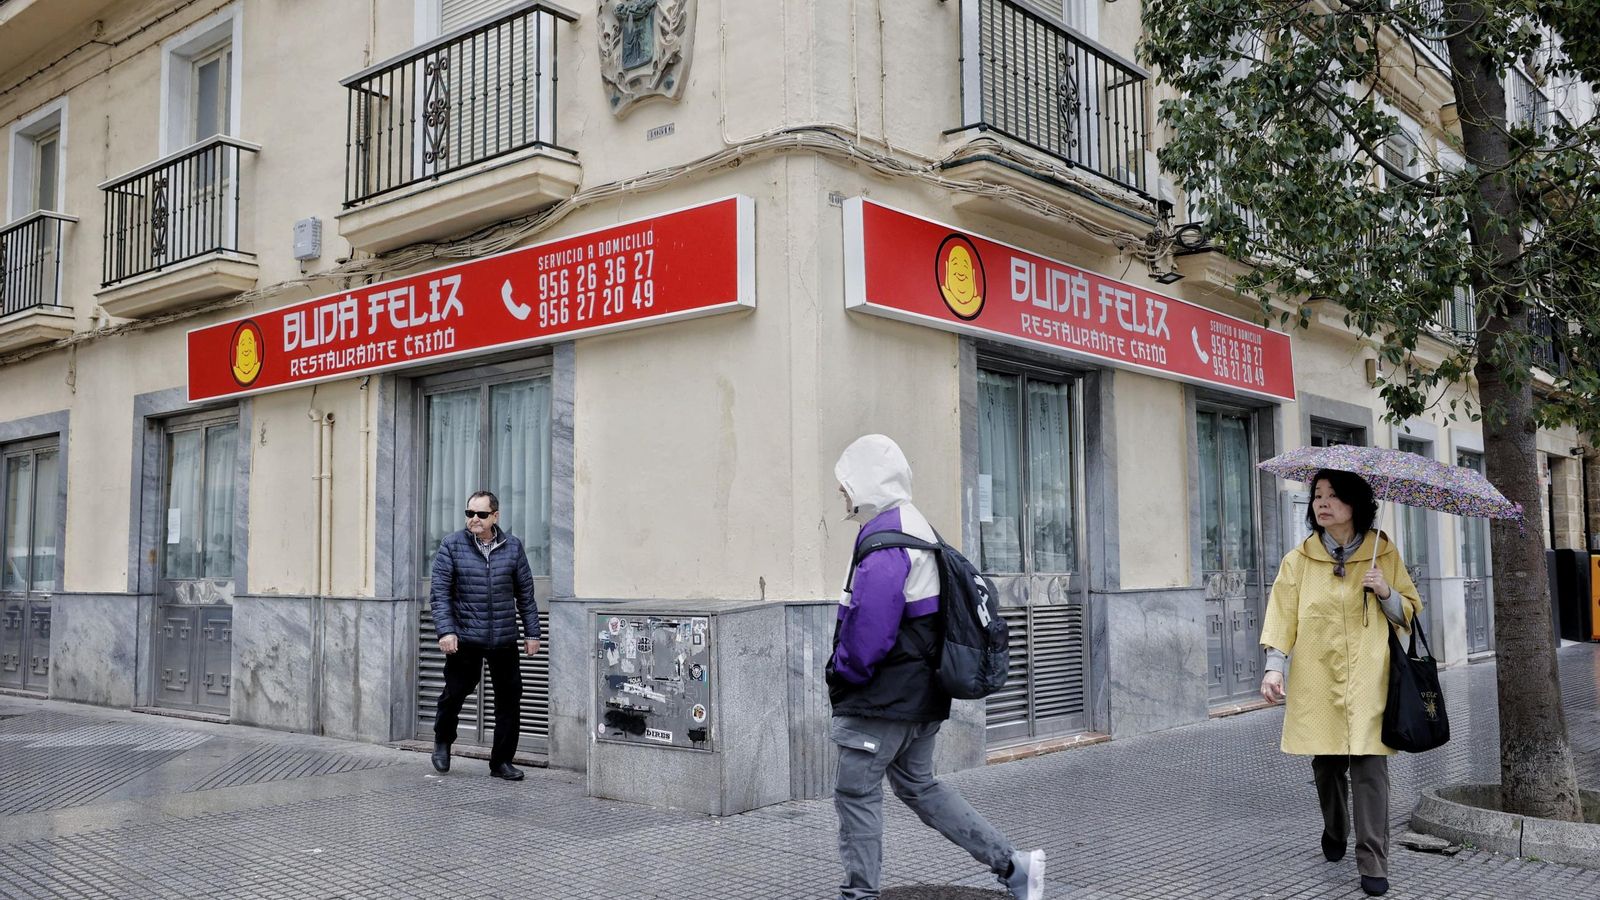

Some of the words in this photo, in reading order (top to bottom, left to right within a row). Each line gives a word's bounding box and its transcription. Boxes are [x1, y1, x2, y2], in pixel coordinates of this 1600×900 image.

[538, 246, 583, 271] SERVICIO
[587, 244, 594, 260] A
[598, 230, 653, 257] DOMICILIO
[538, 268, 569, 301] 956
[576, 262, 597, 293] 26
[604, 255, 626, 287] 36
[634, 249, 654, 281] 27
[367, 273, 464, 335] FELIZ
[538, 296, 569, 328] 956
[576, 291, 596, 321] 27
[603, 285, 624, 317] 20
[631, 279, 654, 310] 49
[1097, 283, 1171, 341] FELIZ
[290, 339, 397, 377] RESTAURANTE
[403, 326, 455, 356] CHINO
[1020, 312, 1126, 356] RESTAURANTE
[1130, 338, 1167, 365] CHINO
[1210, 319, 1232, 337] SERVICIO
[1238, 328, 1262, 345] DOMICILIO
[1211, 334, 1227, 357] 956
[1229, 339, 1240, 361] 26
[1241, 342, 1252, 364] 36
[1253, 346, 1263, 367] 27
[1212, 355, 1229, 378] 956
[1231, 360, 1240, 381] 27
[1242, 363, 1253, 384] 20
[1254, 367, 1265, 387] 49
